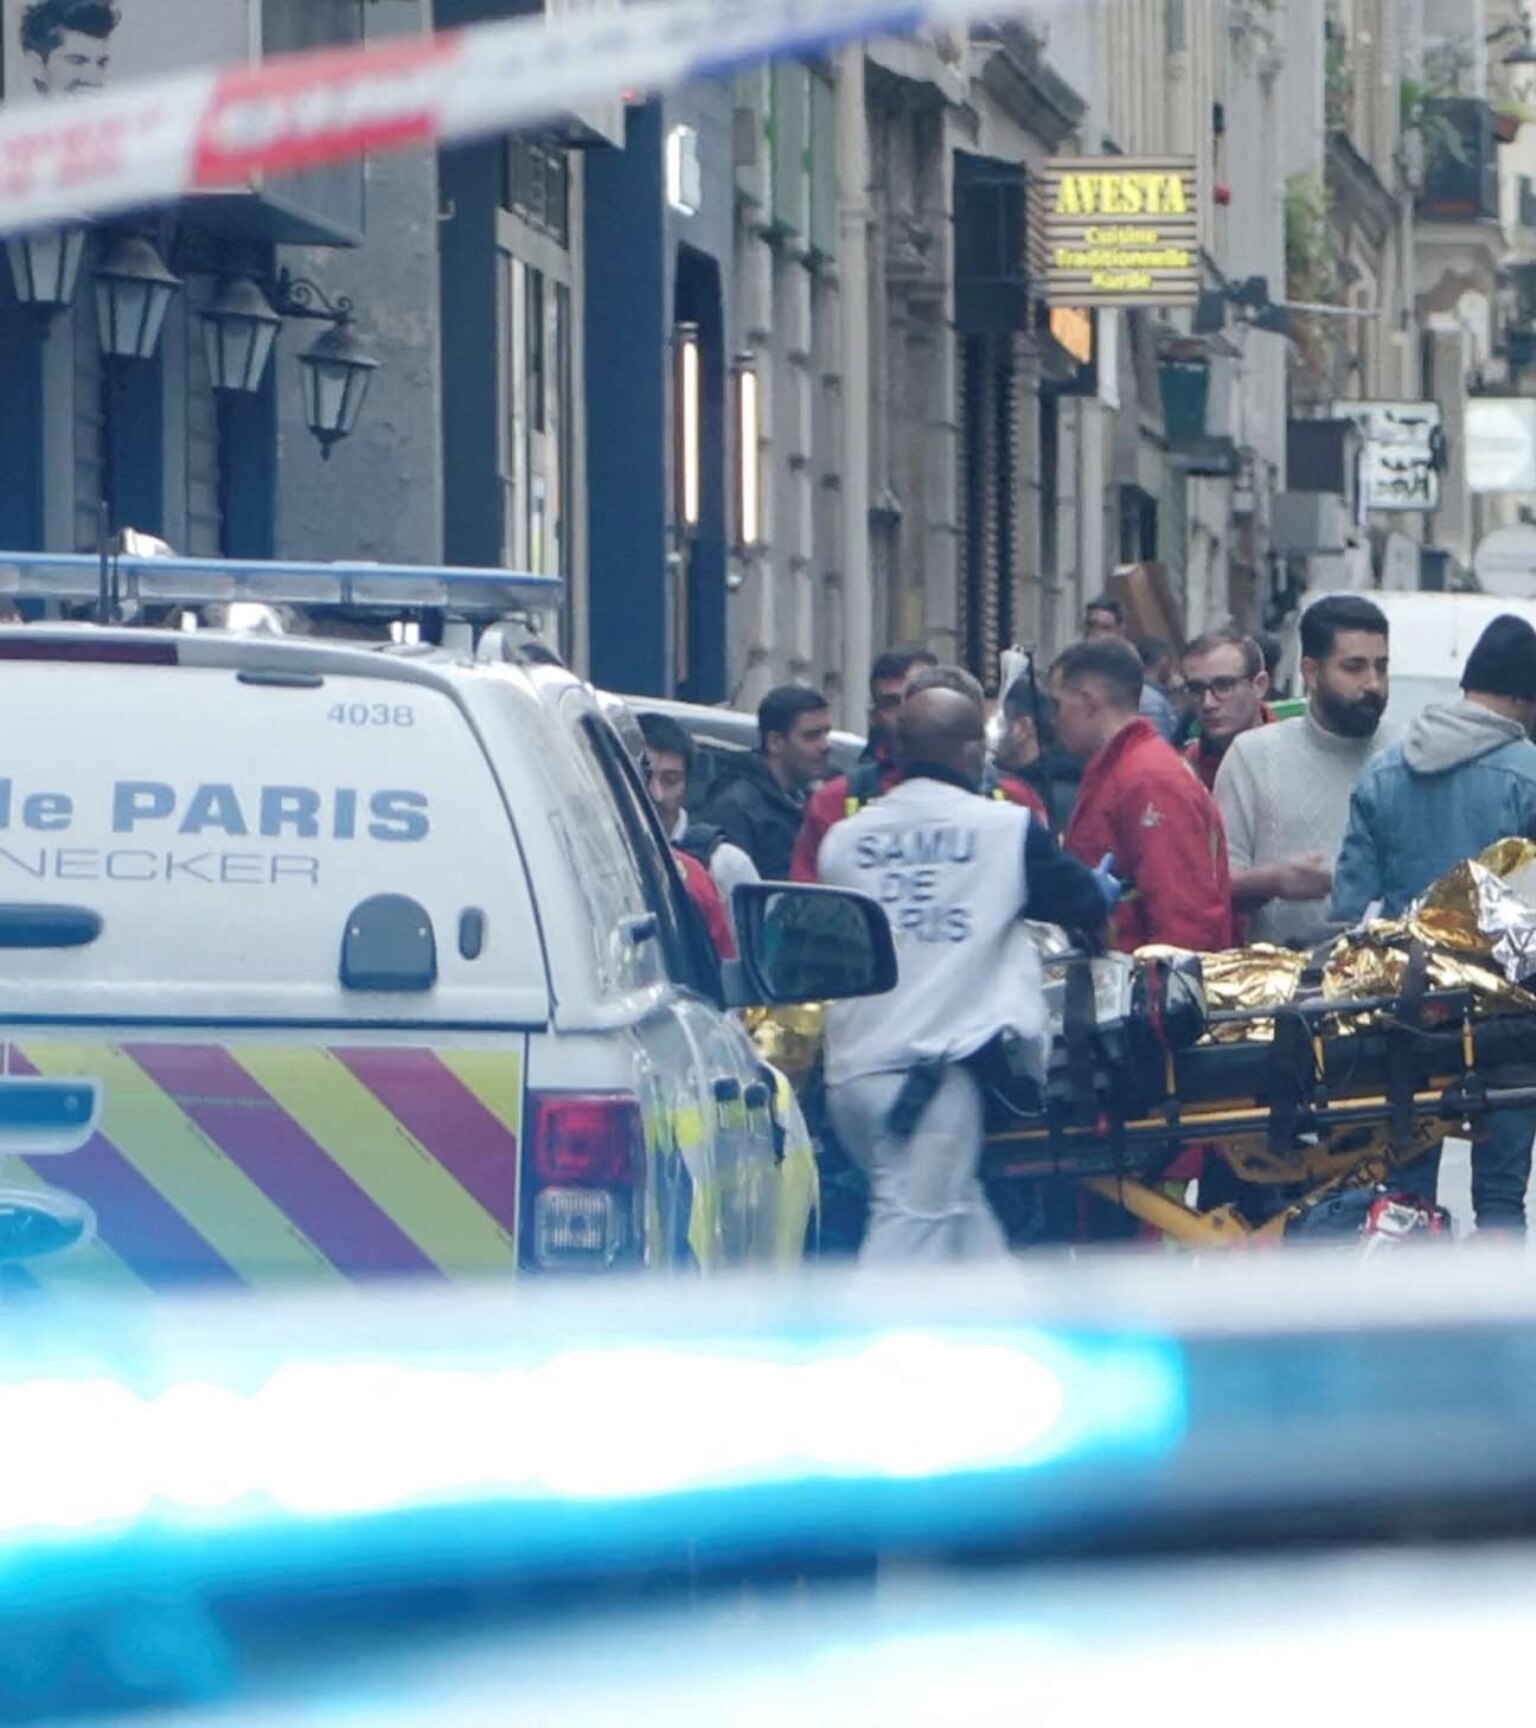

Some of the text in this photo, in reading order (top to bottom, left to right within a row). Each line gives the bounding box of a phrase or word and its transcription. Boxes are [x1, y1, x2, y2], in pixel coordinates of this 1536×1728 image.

[1056, 174, 1187, 213] AVESTA
[1085, 226, 1159, 245] Cuisine
[1055, 248, 1189, 268] Traditionnelle
[327, 702, 415, 727] 4038
[0, 777, 431, 842] e PARIS
[0, 848, 320, 884] NECKER
[857, 829, 976, 869] SAMU
[880, 869, 936, 903] DE
